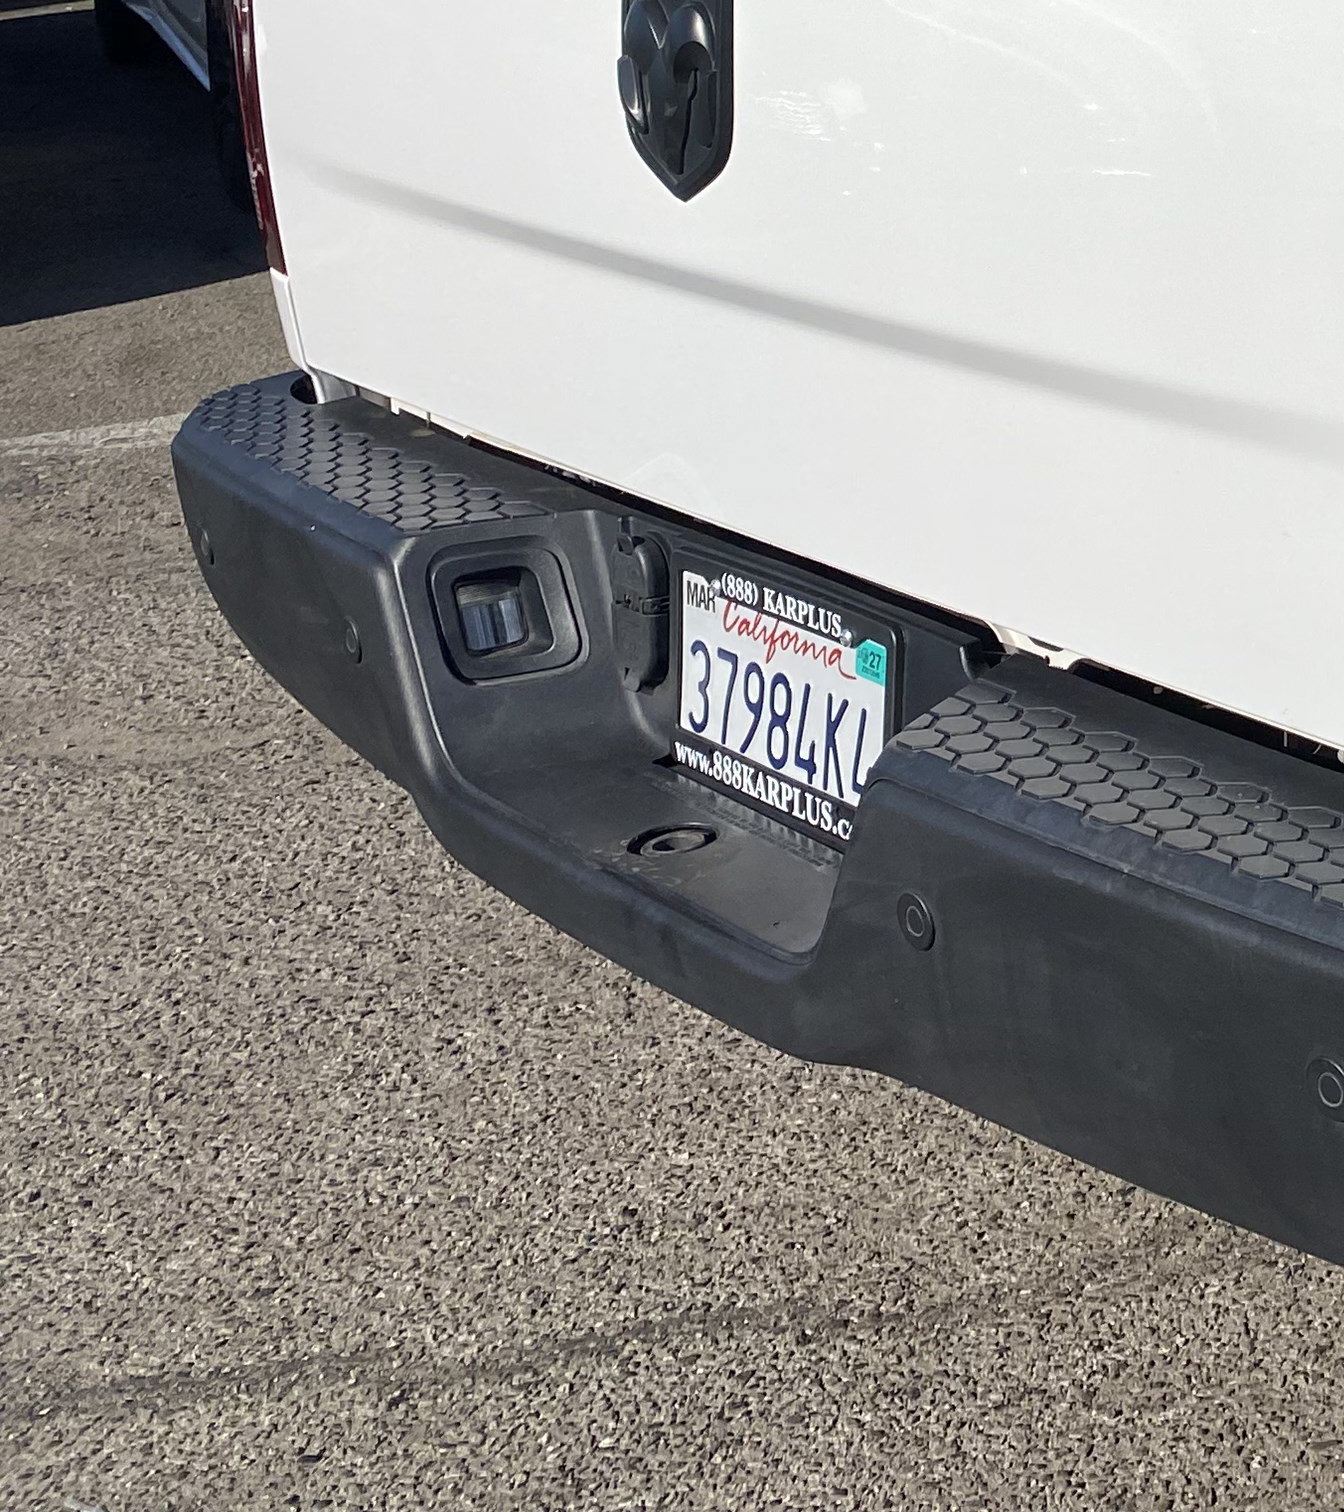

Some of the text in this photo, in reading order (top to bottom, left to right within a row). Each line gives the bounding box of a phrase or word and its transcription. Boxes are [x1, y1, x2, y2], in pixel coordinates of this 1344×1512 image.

[721, 573, 842, 638] (888) KARPLUS
[723, 601, 857, 680] California
[869, 651, 882, 671] 27
